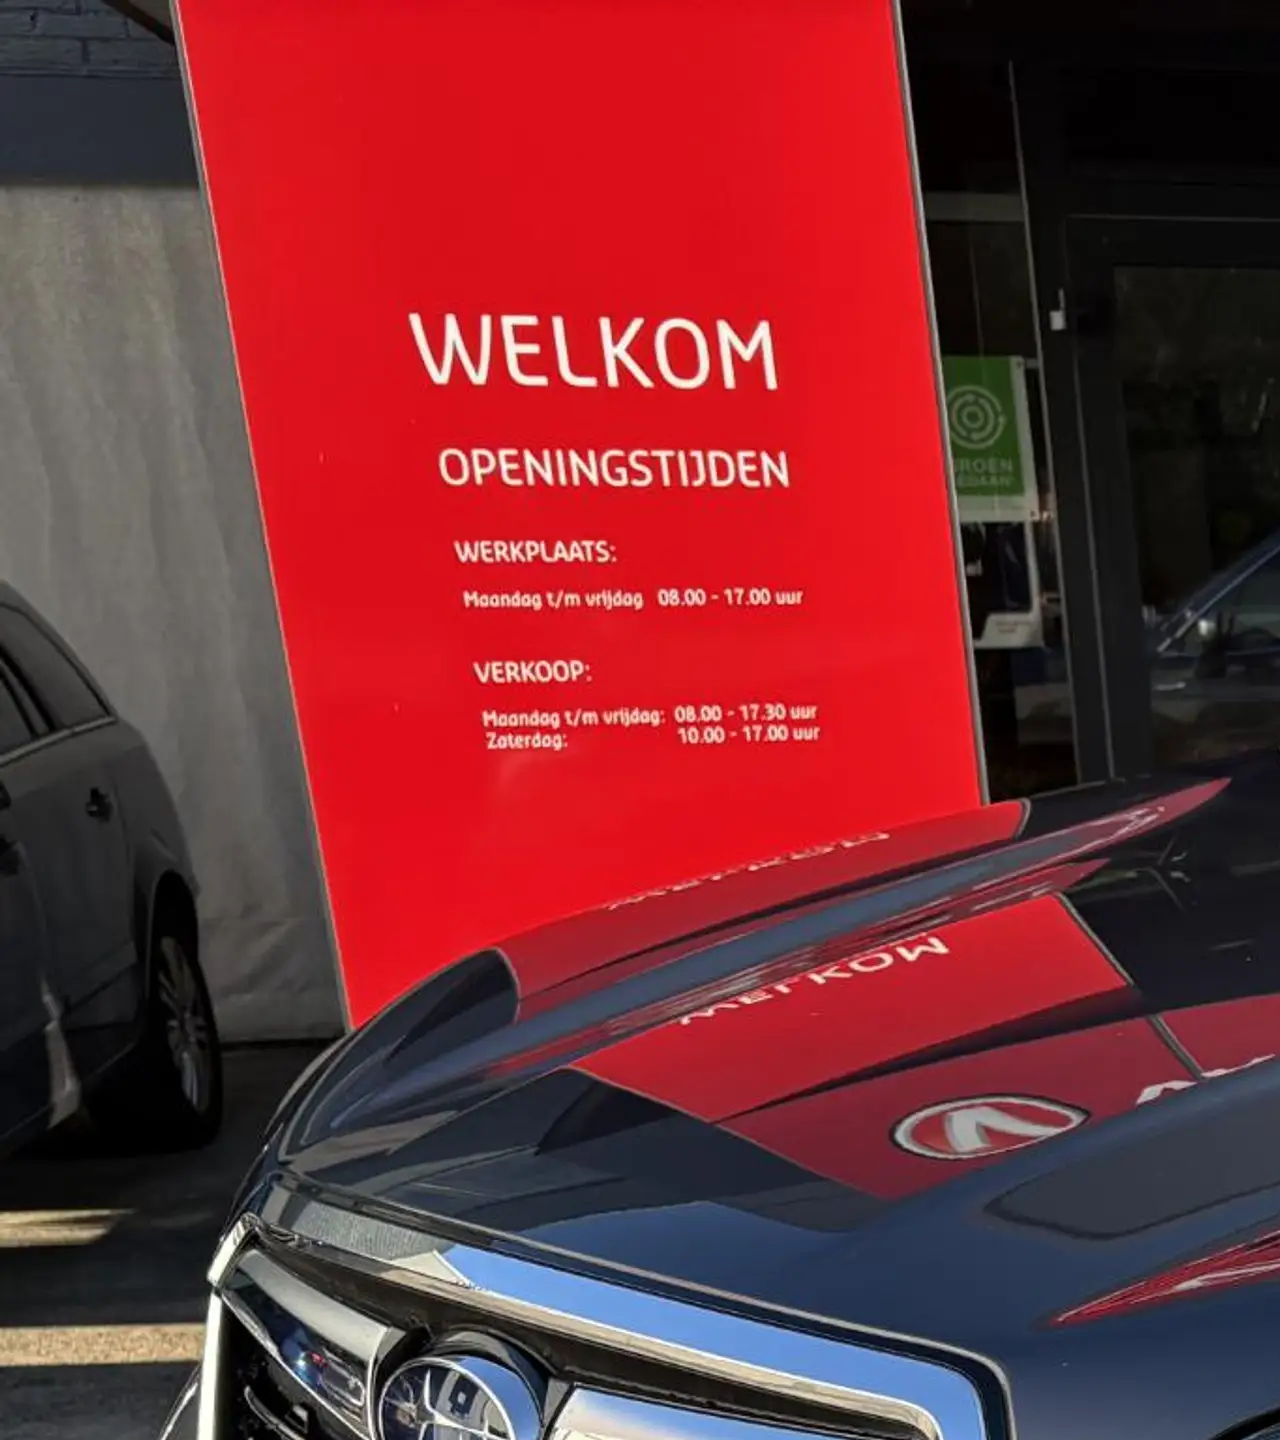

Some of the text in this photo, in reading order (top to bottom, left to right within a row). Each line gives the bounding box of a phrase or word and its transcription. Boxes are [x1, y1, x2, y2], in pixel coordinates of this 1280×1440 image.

[408, 312, 778, 390] WELKOM
[438, 447, 790, 488] OPENINGSTIJDEN
[454, 540, 618, 563] WERKPLAATS:
[463, 590, 543, 611] Maandag
[546, 590, 581, 608] t/m
[585, 590, 645, 611] vrijdag
[657, 588, 707, 607] 08.00
[723, 588, 772, 606] 17.00
[775, 591, 804, 606] uur
[473, 659, 593, 684] VERKOOP:
[482, 709, 561, 730] Maandag
[565, 709, 599, 727] t/m
[602, 707, 666, 727] vrijdag:
[674, 704, 723, 723] 08.00
[739, 703, 787, 721] 17.30
[790, 705, 817, 720] uur
[486, 731, 568, 751] Zaterdag:
[678, 726, 726, 744] 10.00
[742, 724, 789, 742] 17.00
[792, 726, 820, 741] uur
